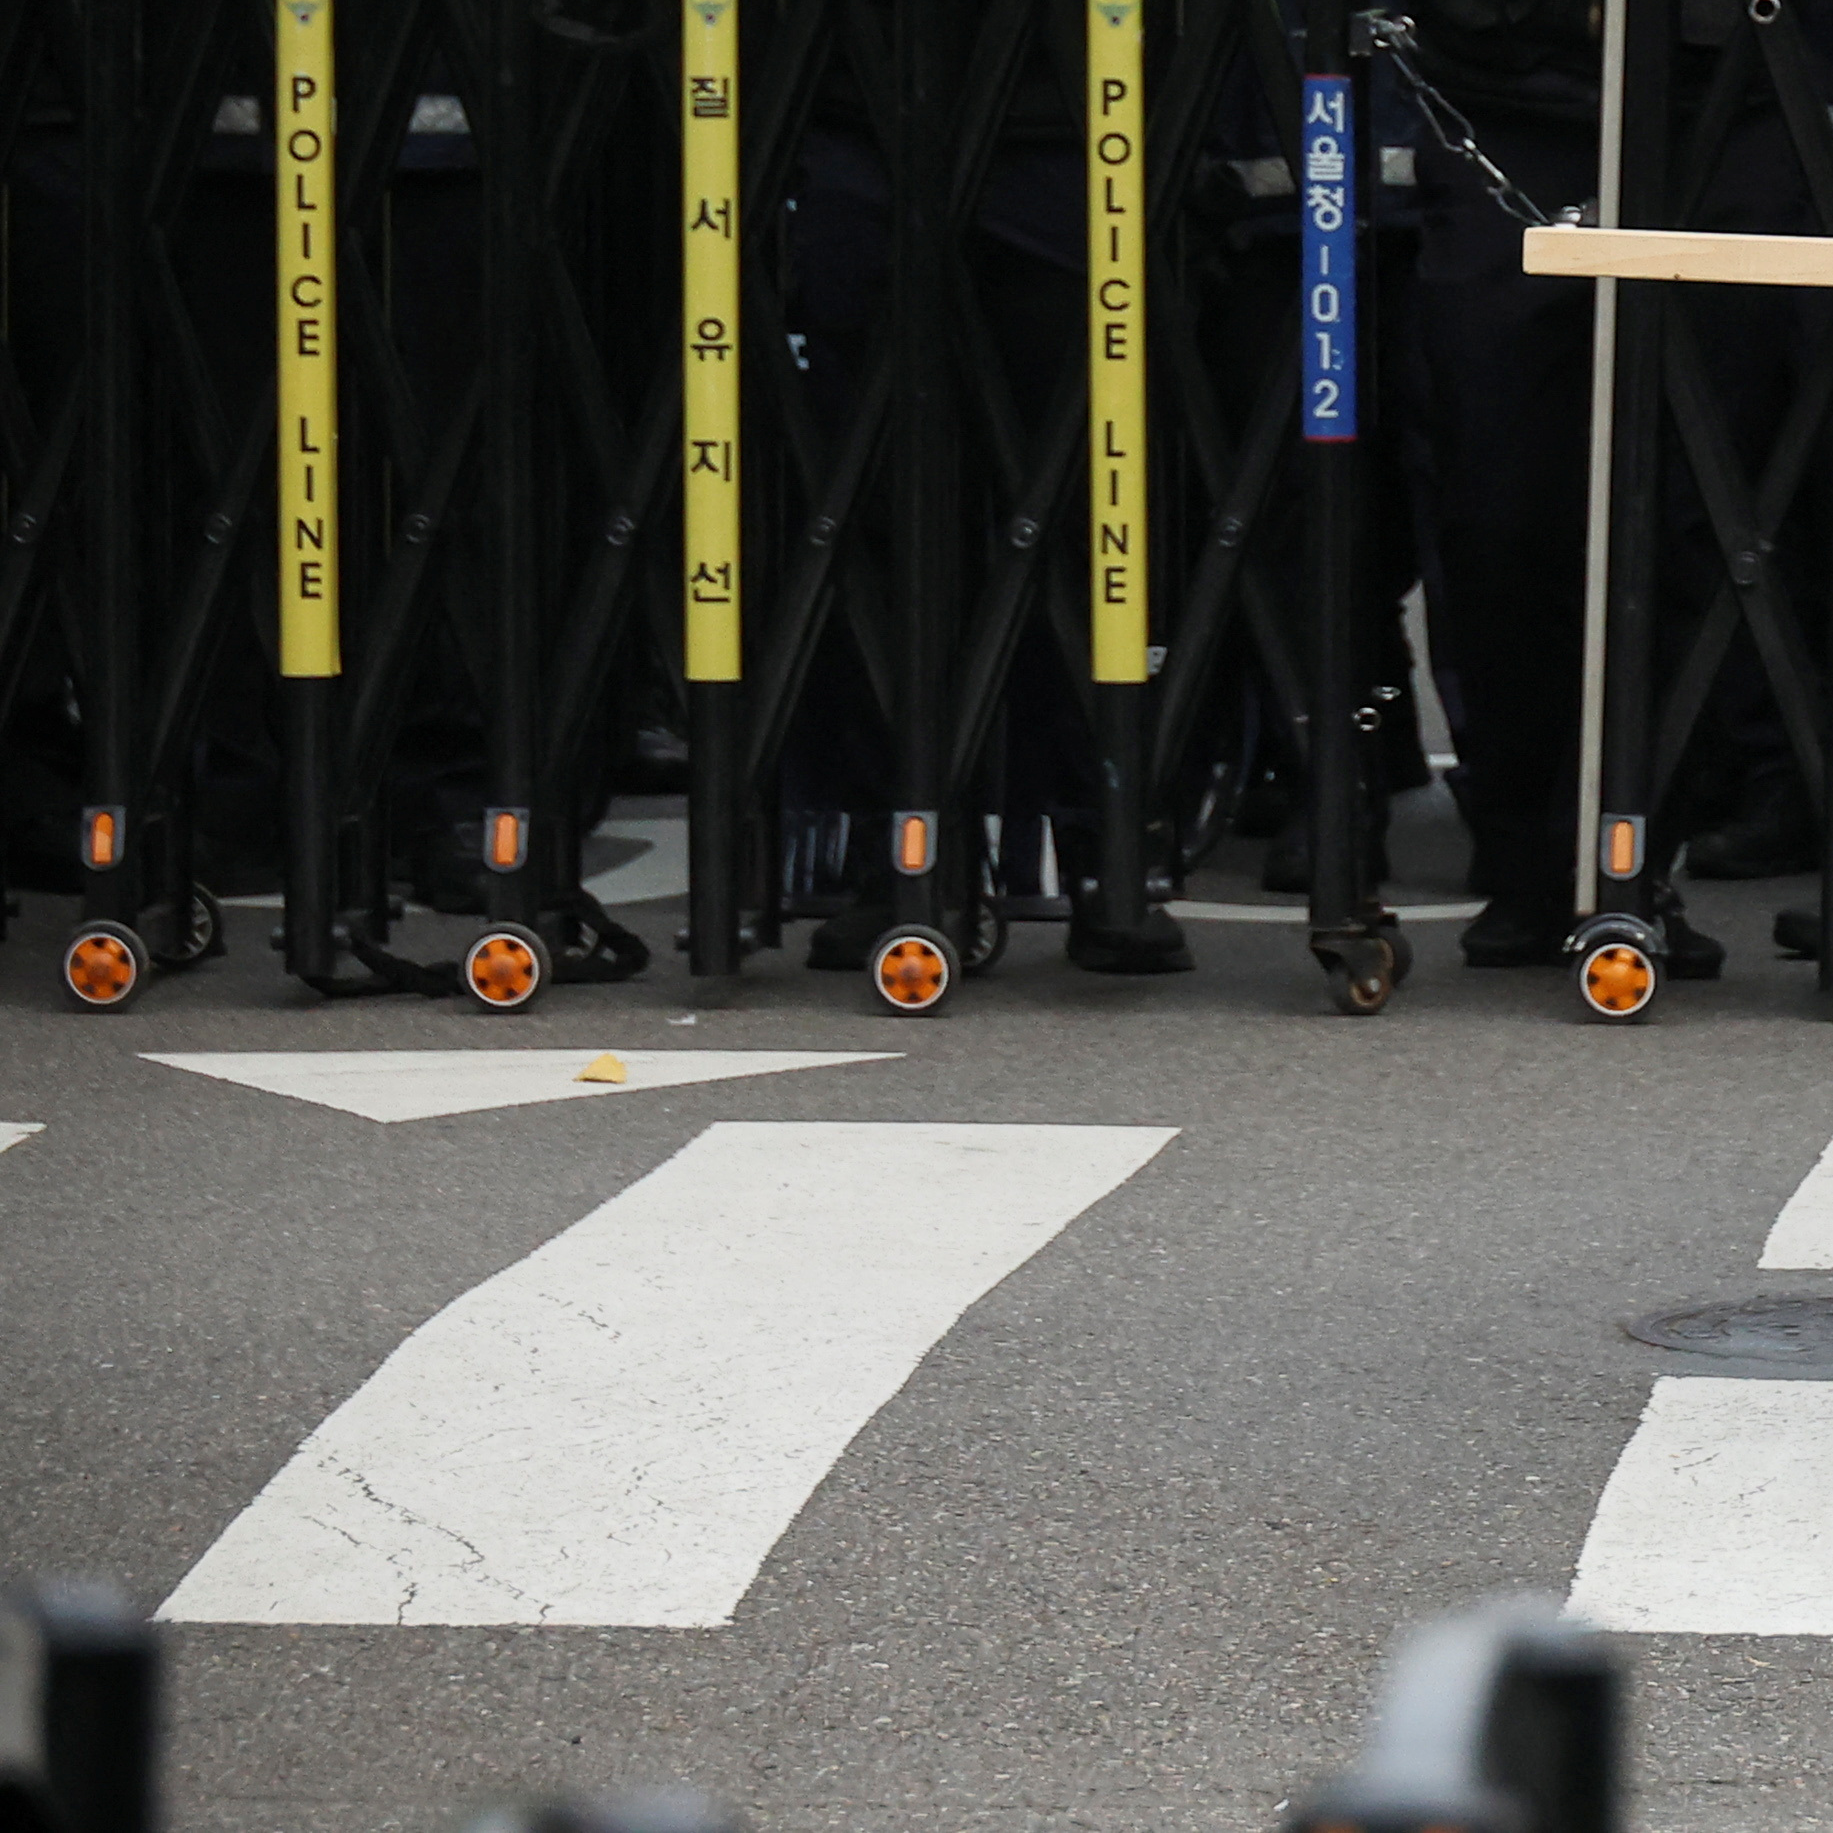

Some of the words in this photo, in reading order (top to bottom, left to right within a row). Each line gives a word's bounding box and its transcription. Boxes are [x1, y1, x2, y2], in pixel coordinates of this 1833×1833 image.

[287, 75, 323, 358] POLICE
[690, 75, 733, 605] 질서유지선
[1097, 78, 1132, 361] POLICE
[297, 416, 325, 600] LINE
[1101, 420, 1130, 605] LINE
